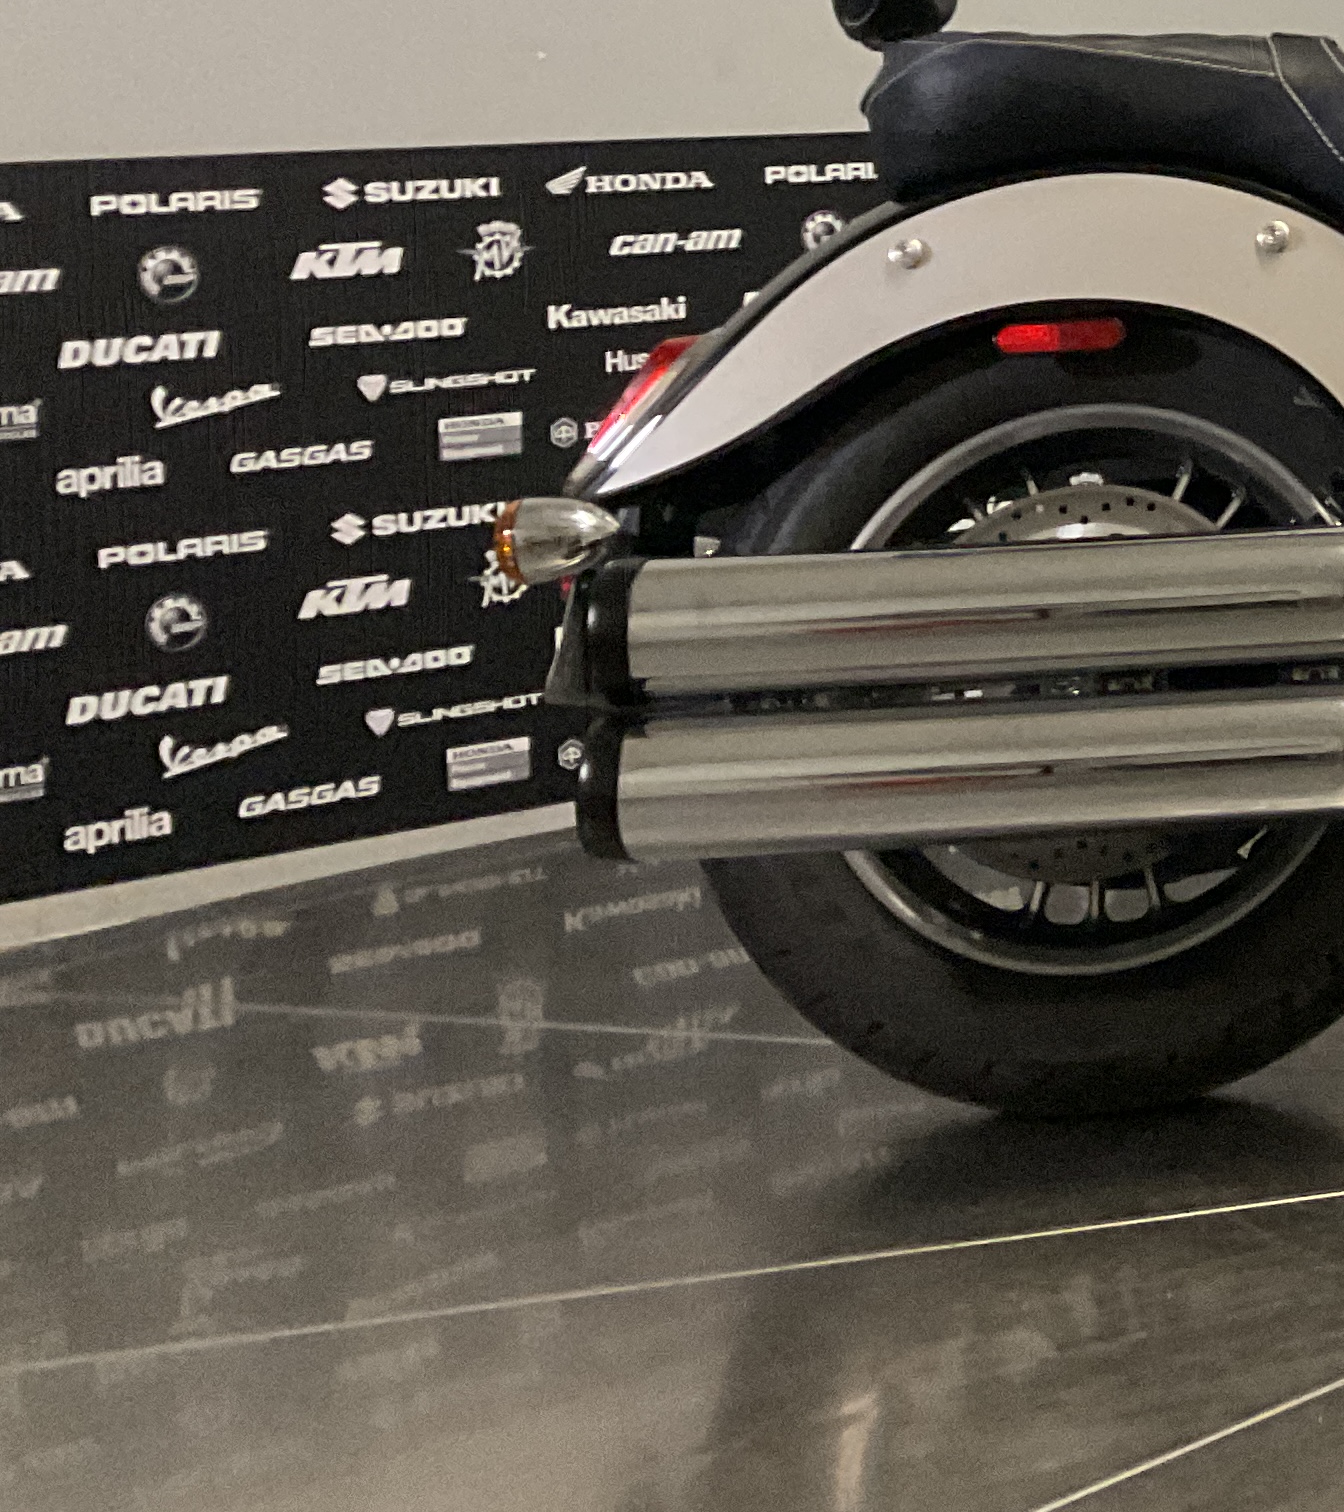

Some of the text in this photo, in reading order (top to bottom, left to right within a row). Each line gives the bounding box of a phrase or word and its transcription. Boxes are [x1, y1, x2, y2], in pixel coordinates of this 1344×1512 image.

[364, 177, 500, 202] SUZUKI
[585, 171, 714, 193] HONDA
[91, 189, 261, 216] POLARIS
[290, 241, 403, 280] KTM
[609, 229, 742, 255] can-am
[547, 296, 686, 329] Kawasaki
[58, 330, 220, 369] DUCATI
[230, 440, 373, 472] GASGAS
[56, 455, 164, 497] aprilia
[98, 531, 268, 568] POLARIS
[298, 574, 411, 619] KTM
[66, 676, 228, 725] DUCATI
[239, 776, 380, 818] GASGAS
[64, 807, 172, 854] aprilia
